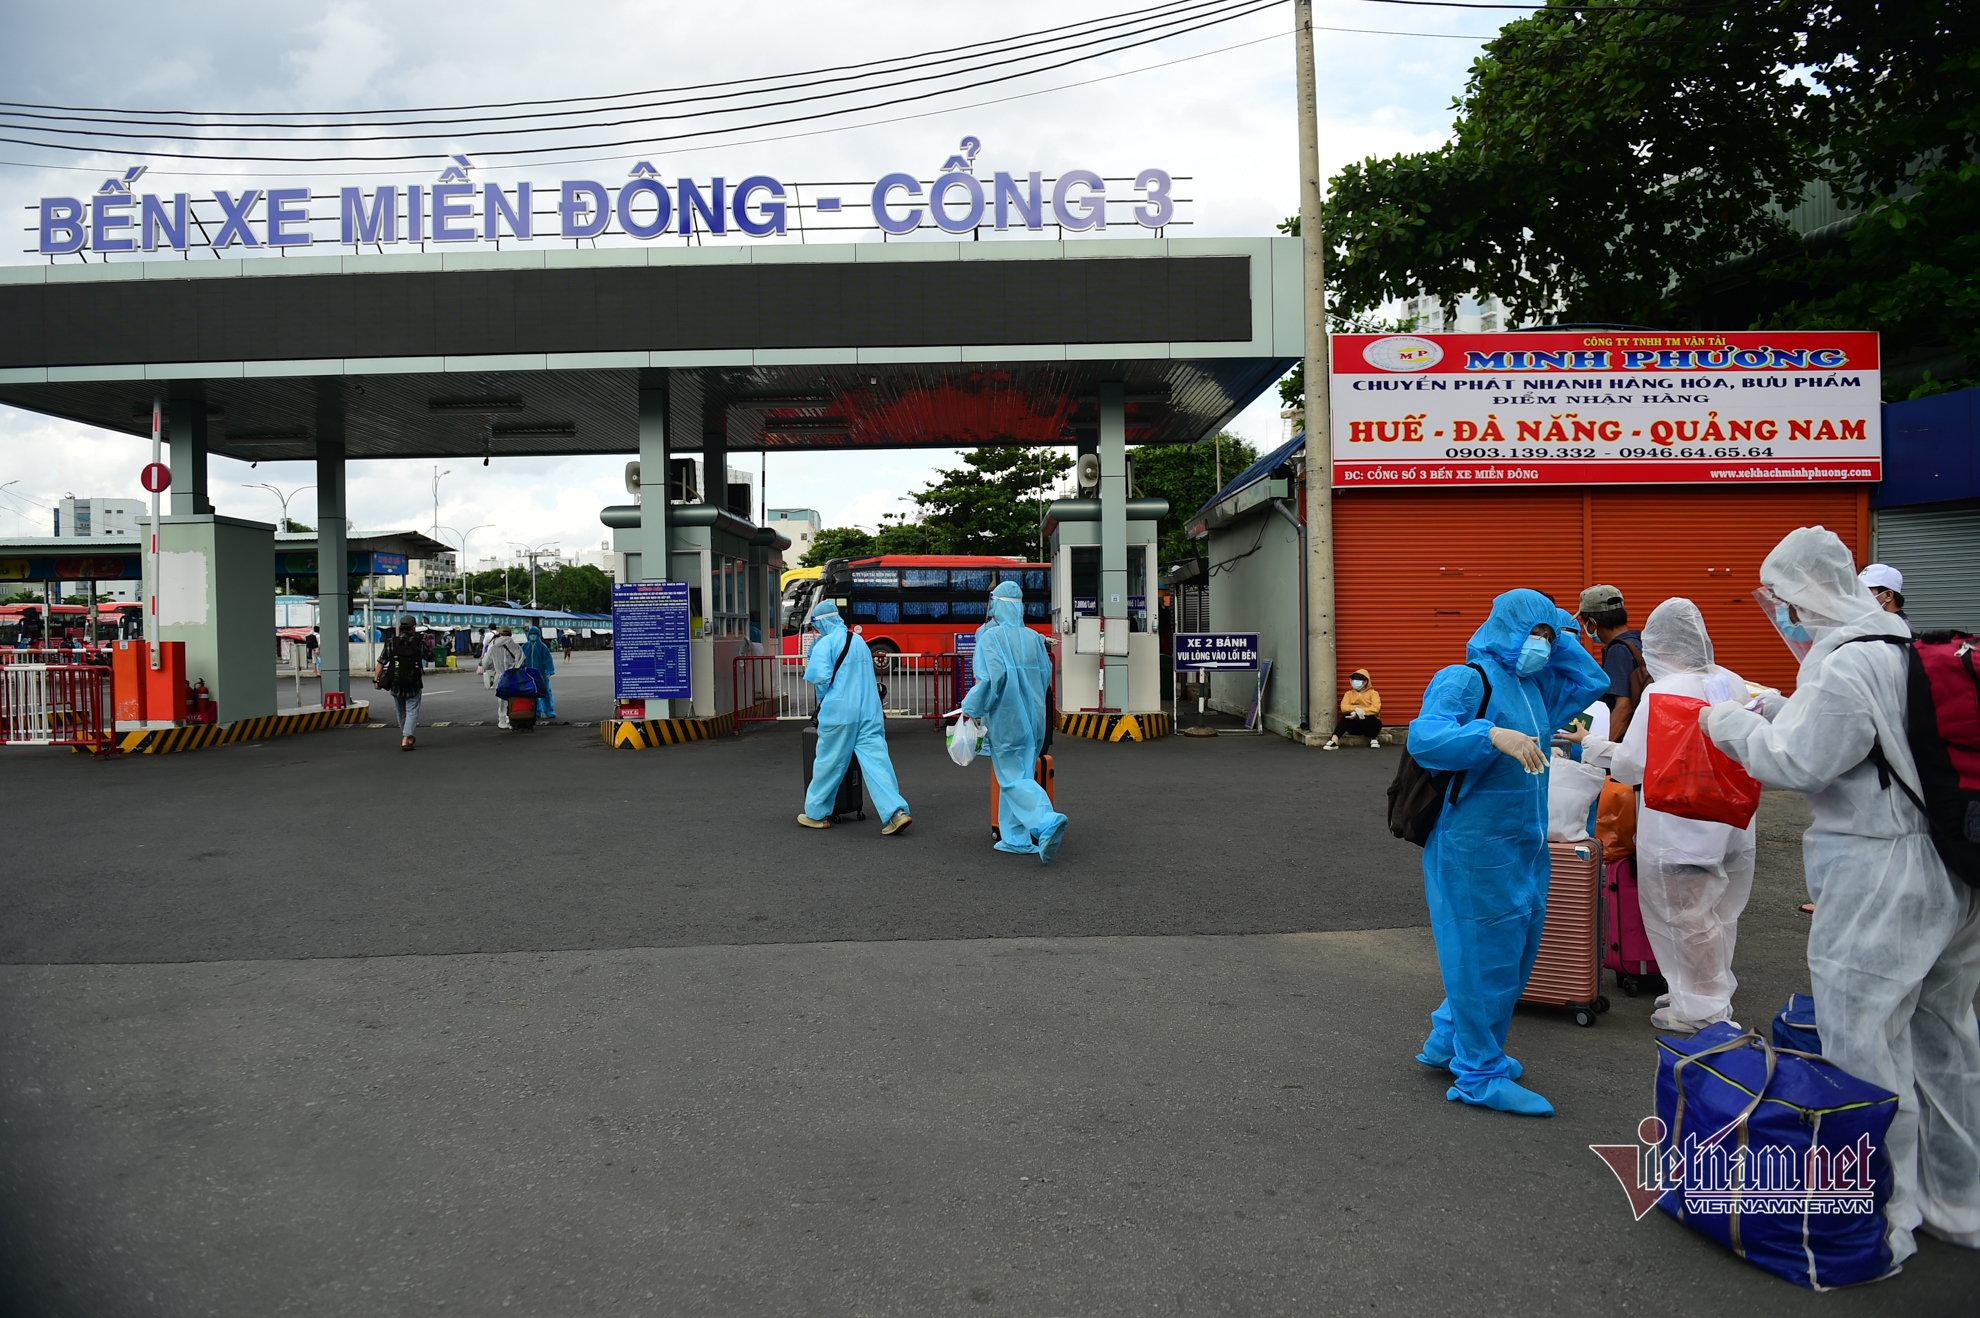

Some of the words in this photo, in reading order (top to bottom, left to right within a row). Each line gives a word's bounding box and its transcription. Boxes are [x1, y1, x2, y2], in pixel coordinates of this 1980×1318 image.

[39, 165, 191, 255] BẾN
[211, 187, 313, 249] XE
[340, 153, 533, 246] MIỀN
[558, 161, 787, 240] ĐÔNG
[816, 197, 841, 212] -
[870, 135, 1107, 235] CỔNG
[1133, 168, 1174, 229] 3
[1583, 336, 1613, 346] CÔNG
[1616, 337, 1629, 346] TY
[1632, 337, 1662, 346] TNHH
[1666, 337, 1681, 345] TM
[1683, 336, 1705, 347] VẬN
[1708, 335, 1726, 345] TẢI
[1464, 350, 1613, 371] MINH
[1621, 345, 1850, 369] PHƯƠNG
[1352, 375, 1447, 391] CHUYỂN
[1454, 377, 1516, 390] PHÁT
[1523, 379, 1602, 390] NHANH
[1609, 376, 1674, 389] HÀNG
[1681, 376, 1735, 390] HÓA,
[1742, 376, 1787, 388] BƯU
[1794, 372, 1861, 388] PHẨM
[1493, 391, 1557, 404] ĐIỂM
[1566, 393, 1633, 405] NHẬN
[1642, 392, 1710, 403] HÀNG
[1349, 413, 1428, 442] HUẾ
[1434, 429, 1444, 437] -
[1453, 414, 1505, 442] ĐÀ
[1516, 412, 1623, 442] NẴNG
[1650, 410, 1779, 446] QUẢNG
[1787, 419, 1867, 441] NAM
[1445, 447, 1596, 458] 0903.139.332
[1619, 446, 1774, 458] 0946.64.65.64
[1344, 470, 1364, 480] ĐC:
[1367, 466, 1399, 480] CỔNG
[1401, 467, 1417, 480] SỐ
[1419, 470, 1427, 479] 3
[1430, 466, 1453, 479] BẾN
[1456, 470, 1472, 479] XE
[1475, 465, 1504, 479] MIỀN
[1507, 468, 1539, 479] ĐÔNG
[1710, 467, 1872, 480] www.xekhachminhphuong.com
[1187, 638, 1202, 648] XE
[1205, 638, 1213, 647] 2
[1216, 636, 1247, 647] BÁNH
[1177, 652, 1189, 660] VUI
[1191, 649, 1210, 660] LÒNG
[1211, 649, 1226, 660] VÀO
[1228, 648, 1240, 660] LỐI
[1241, 649, 1257, 660] BÊN
